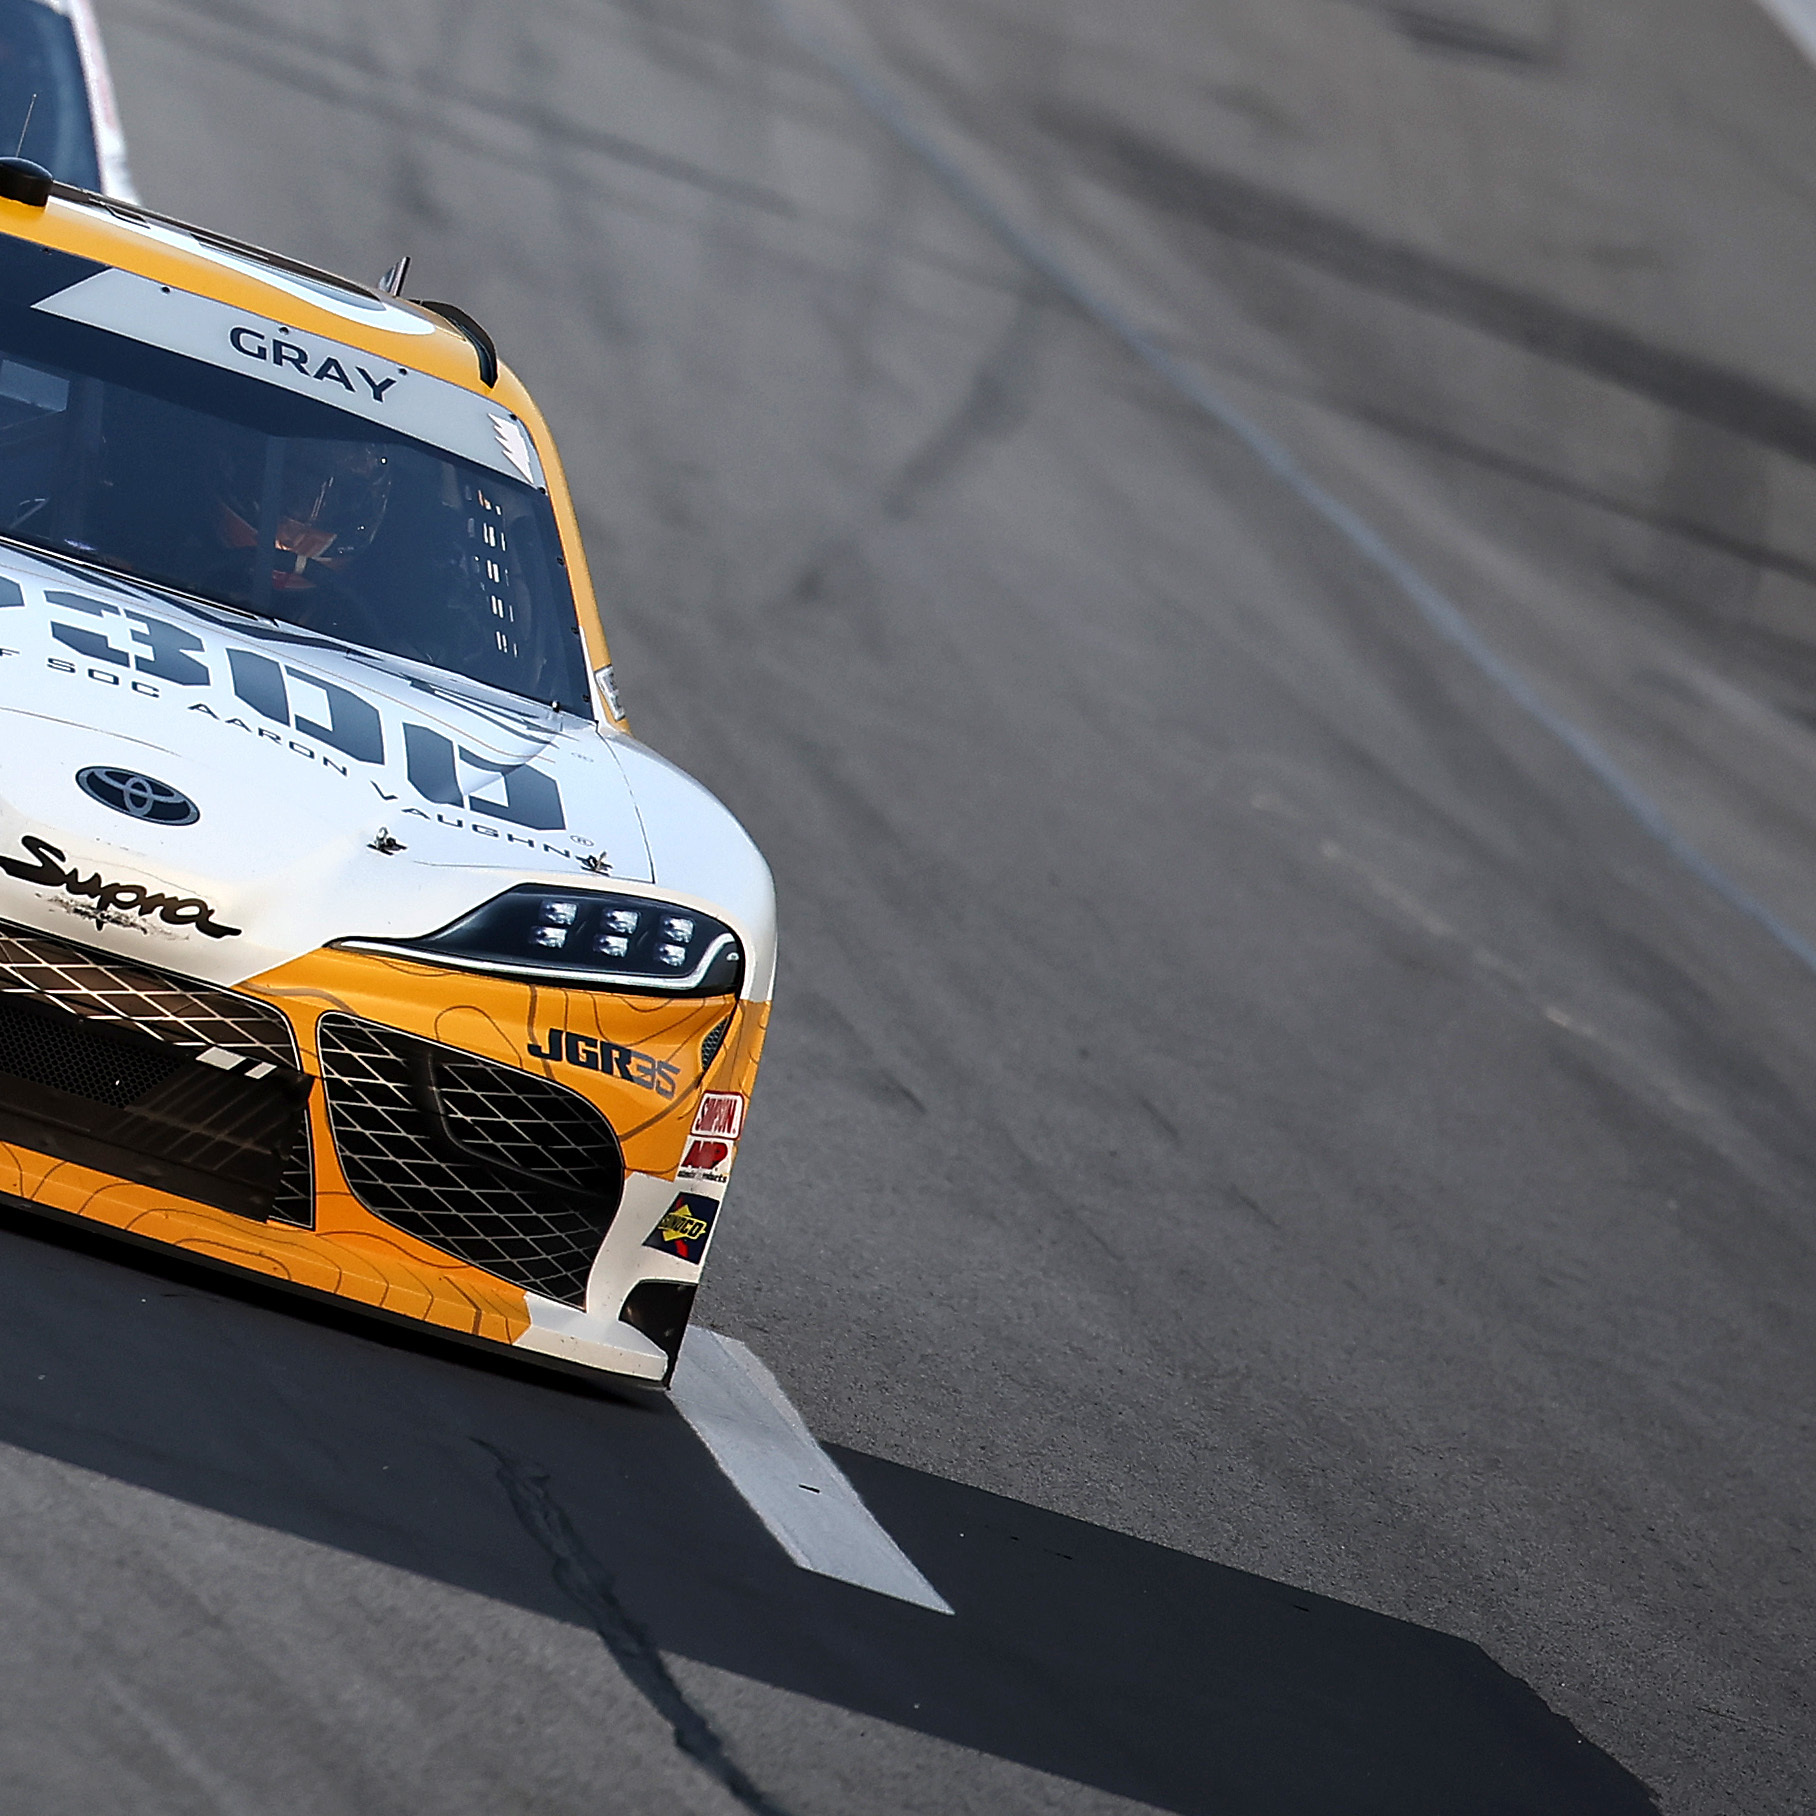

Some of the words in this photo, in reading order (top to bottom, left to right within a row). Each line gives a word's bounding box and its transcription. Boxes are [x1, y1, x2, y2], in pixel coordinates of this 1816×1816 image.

[229, 326, 397, 403] GRAY
[46, 657, 163, 699] SOC
[188, 702, 349, 778] AARON
[370, 780, 572, 859] VAUGHN
[528, 1028, 680, 1101] JGR35
[658, 1212, 707, 1240] SUNOCO
